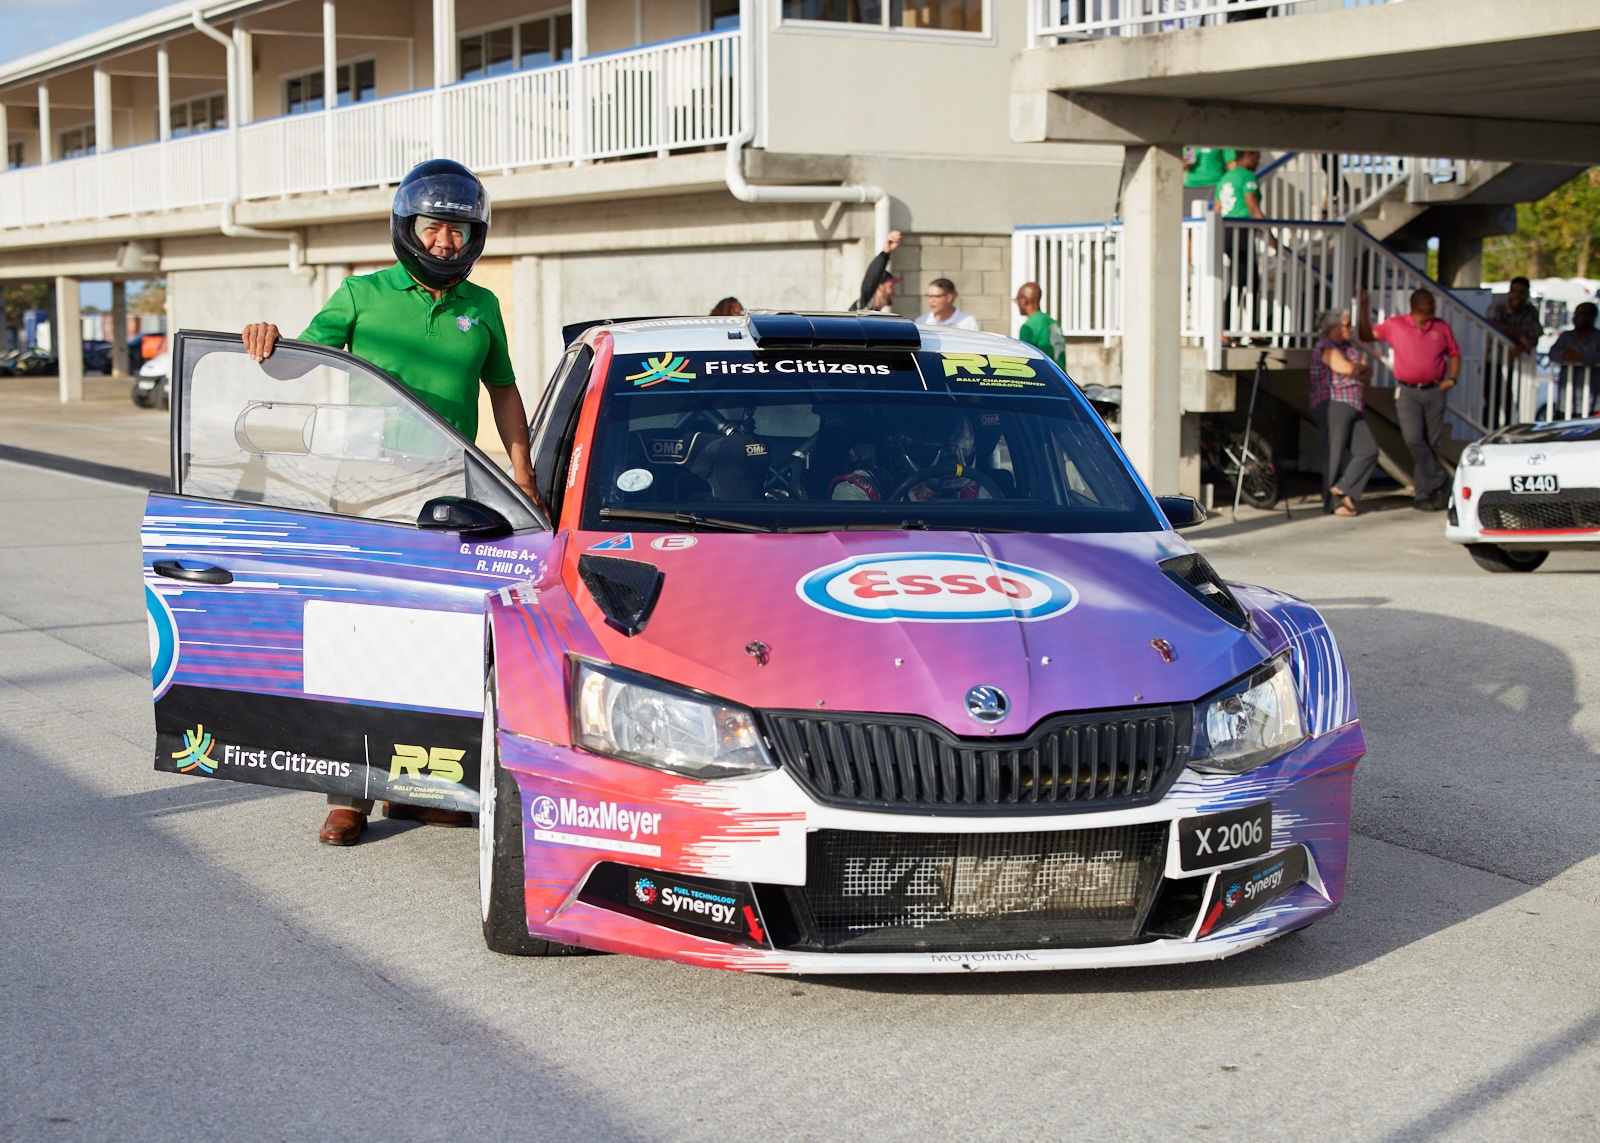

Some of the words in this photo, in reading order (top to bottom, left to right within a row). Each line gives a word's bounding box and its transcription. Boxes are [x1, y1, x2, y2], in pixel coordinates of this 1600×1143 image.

[433, 201, 473, 211] LS2
[705, 360, 769, 375] First
[774, 360, 892, 376] Citizens
[940, 352, 1037, 378] R5
[982, 378, 1046, 387] CHAMPIONSHIP
[980, 415, 1000, 425] OMP
[652, 441, 684, 455] OMP
[661, 537, 687, 548] E
[460, 543, 472, 555] G.
[475, 544, 519, 560] Gittens
[518, 549, 538, 561] A+
[476, 559, 489, 572] R.
[491, 561, 513, 573] Hill
[223, 744, 267, 768] First
[270, 750, 351, 777] Citizens
[387, 743, 467, 783] R5
[413, 786, 465, 796] CHAMPIONSHIP
[559, 797, 662, 840] MaxMeyer
[1194, 827, 1213, 856] X
[1217, 817, 1263, 852] 2006
[1243, 868, 1285, 899] Synergy
[673, 886, 690, 896] FUEL
[690, 890, 736, 905] TECHNOLOGY
[661, 887, 736, 924] Synergy
